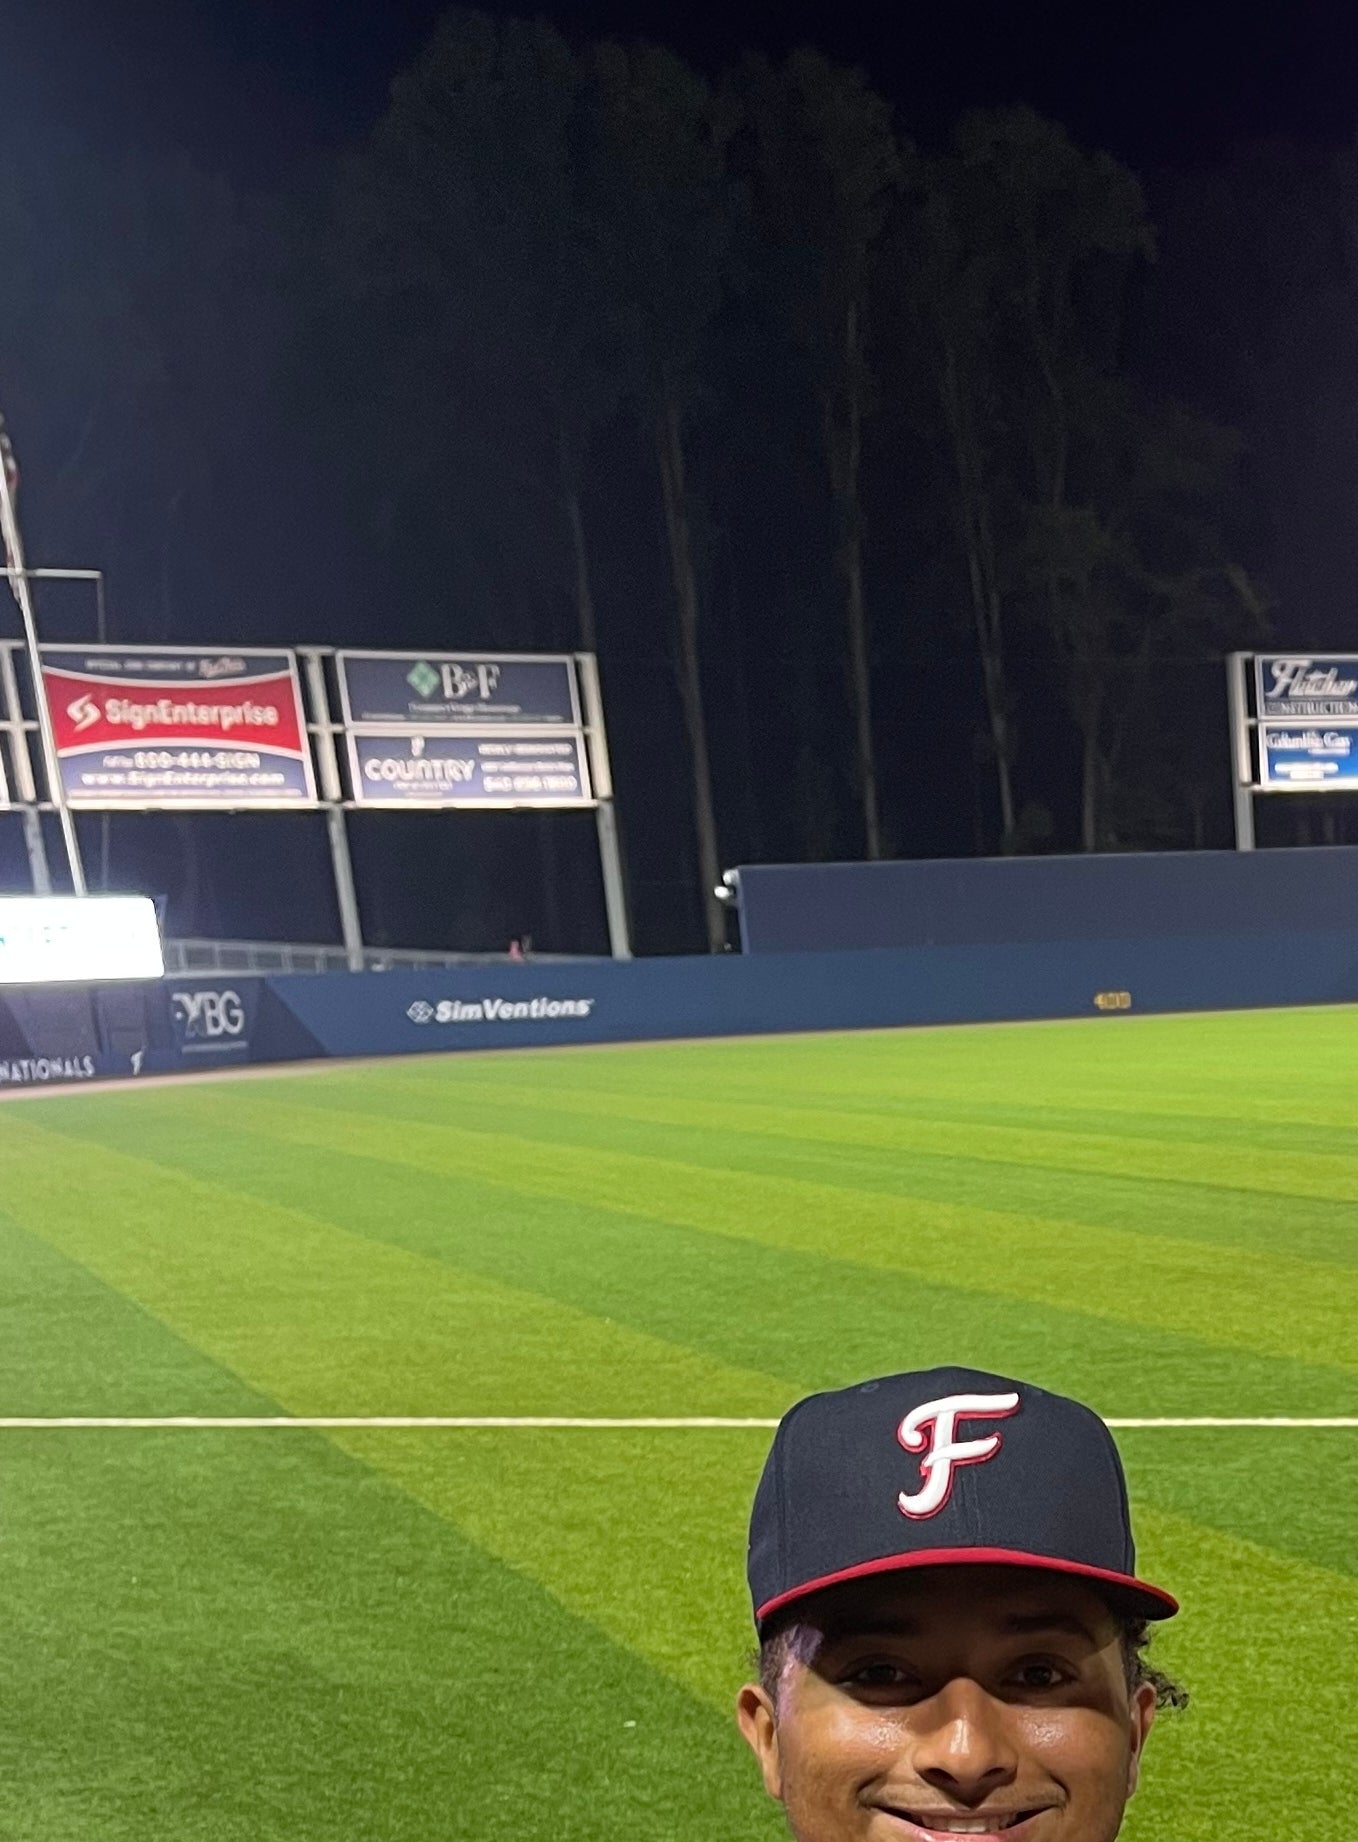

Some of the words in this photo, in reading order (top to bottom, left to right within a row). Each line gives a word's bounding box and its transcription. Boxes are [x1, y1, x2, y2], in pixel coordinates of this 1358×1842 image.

[104, 697, 280, 731] SignEnterprise
[364, 757, 476, 783] COUNTRY
[435, 997, 592, 1023] SimVentions
[897, 1391, 1020, 1520] F
